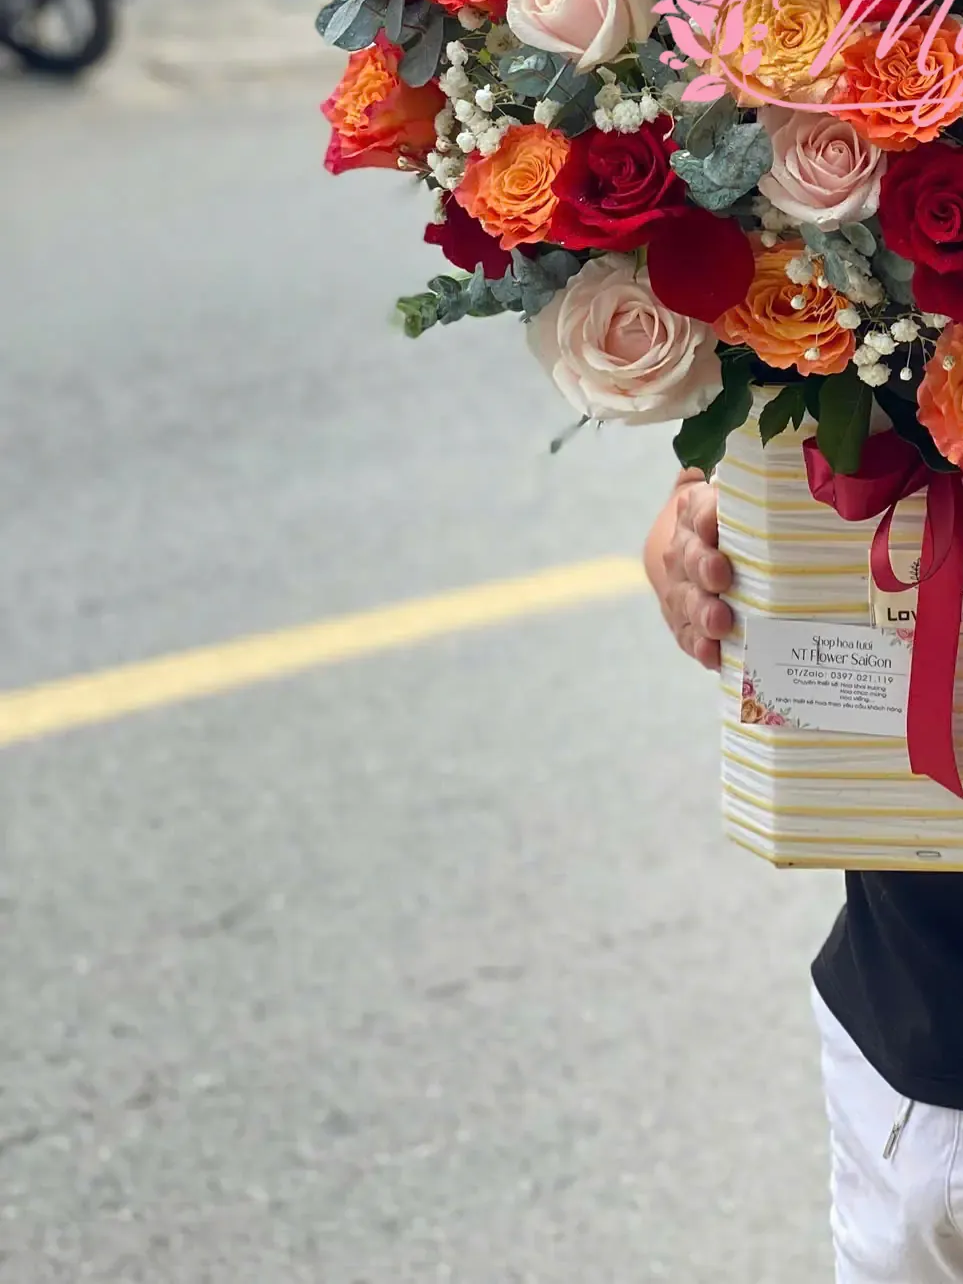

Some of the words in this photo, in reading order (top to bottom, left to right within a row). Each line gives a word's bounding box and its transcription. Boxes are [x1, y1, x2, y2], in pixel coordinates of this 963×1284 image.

[812, 635, 835, 650] Shop
[836, 636, 854, 649] hoa
[791, 648, 808, 661] NT
[810, 647, 848, 665] Flower
[851, 652, 892, 669] SaiGon
